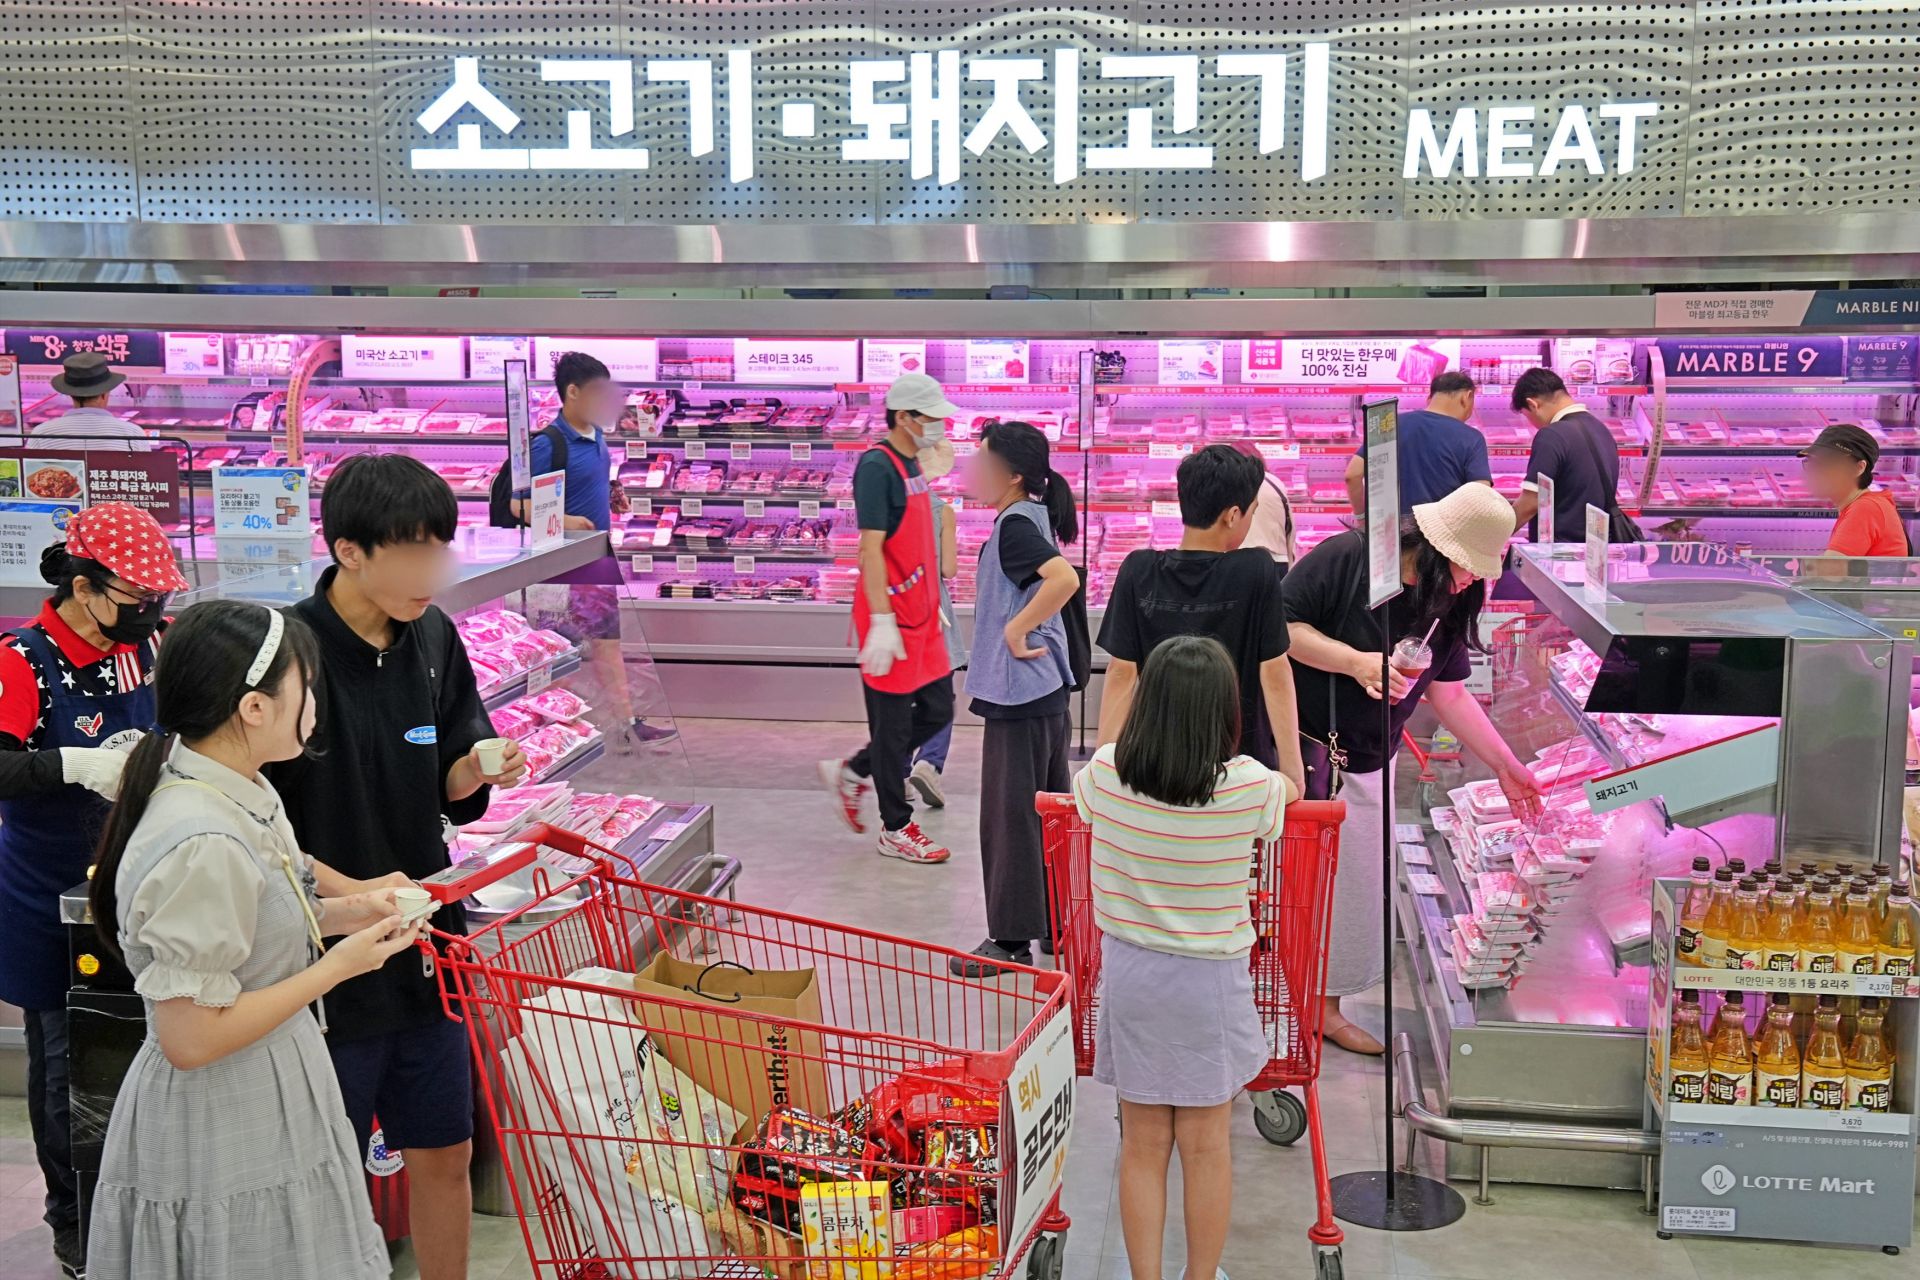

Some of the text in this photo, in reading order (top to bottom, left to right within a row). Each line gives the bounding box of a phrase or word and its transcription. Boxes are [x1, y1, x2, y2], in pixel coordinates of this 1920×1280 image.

[1403, 102, 1658, 179] MEAT
[1685, 299, 1701, 310] 전문
[1703, 299, 1728, 309] MD가
[1731, 299, 1747, 310] 직접
[1836, 301, 1898, 314] MARBLE
[1689, 309, 1768, 320] 마블링 최고등급 한우
[1858, 340, 1908, 351] MARBLE 9
[355, 350, 419, 361] 미국산 소고기
[748, 353, 813, 365] 스테이크 345
[1301, 348, 1397, 362] 더 맛있는 한우에
[1676, 347, 1819, 373] MARBLE 9
[1301, 364, 1367, 377] 100% 진심
[89, 469, 148, 481] 제주 흑돼지와
[89, 481, 169, 493] 쉐프의 특급 레시피
[242, 514, 272, 529] 40%
[546, 512, 562, 538] 40%
[1594, 779, 1639, 803] 돼지고기
[1683, 975, 1714, 984] LOTTE
[1735, 975, 1850, 990] 대한민국 정통 1등 요리주
[1868, 983, 1891, 991] 2,170
[1018, 1063, 1042, 1113] 역시
[1674, 1083, 1703, 1099] 미림
[1709, 1082, 1734, 1100] 미림
[1769, 1088, 1797, 1103] 미림
[1812, 1089, 1841, 1105] 미림
[1861, 1091, 1889, 1108] 미림
[1862, 1139, 1909, 1149] 1566-9981
[1742, 1175, 1876, 1195] LOTTE Mart
[822, 1214, 865, 1232] 콤부차
